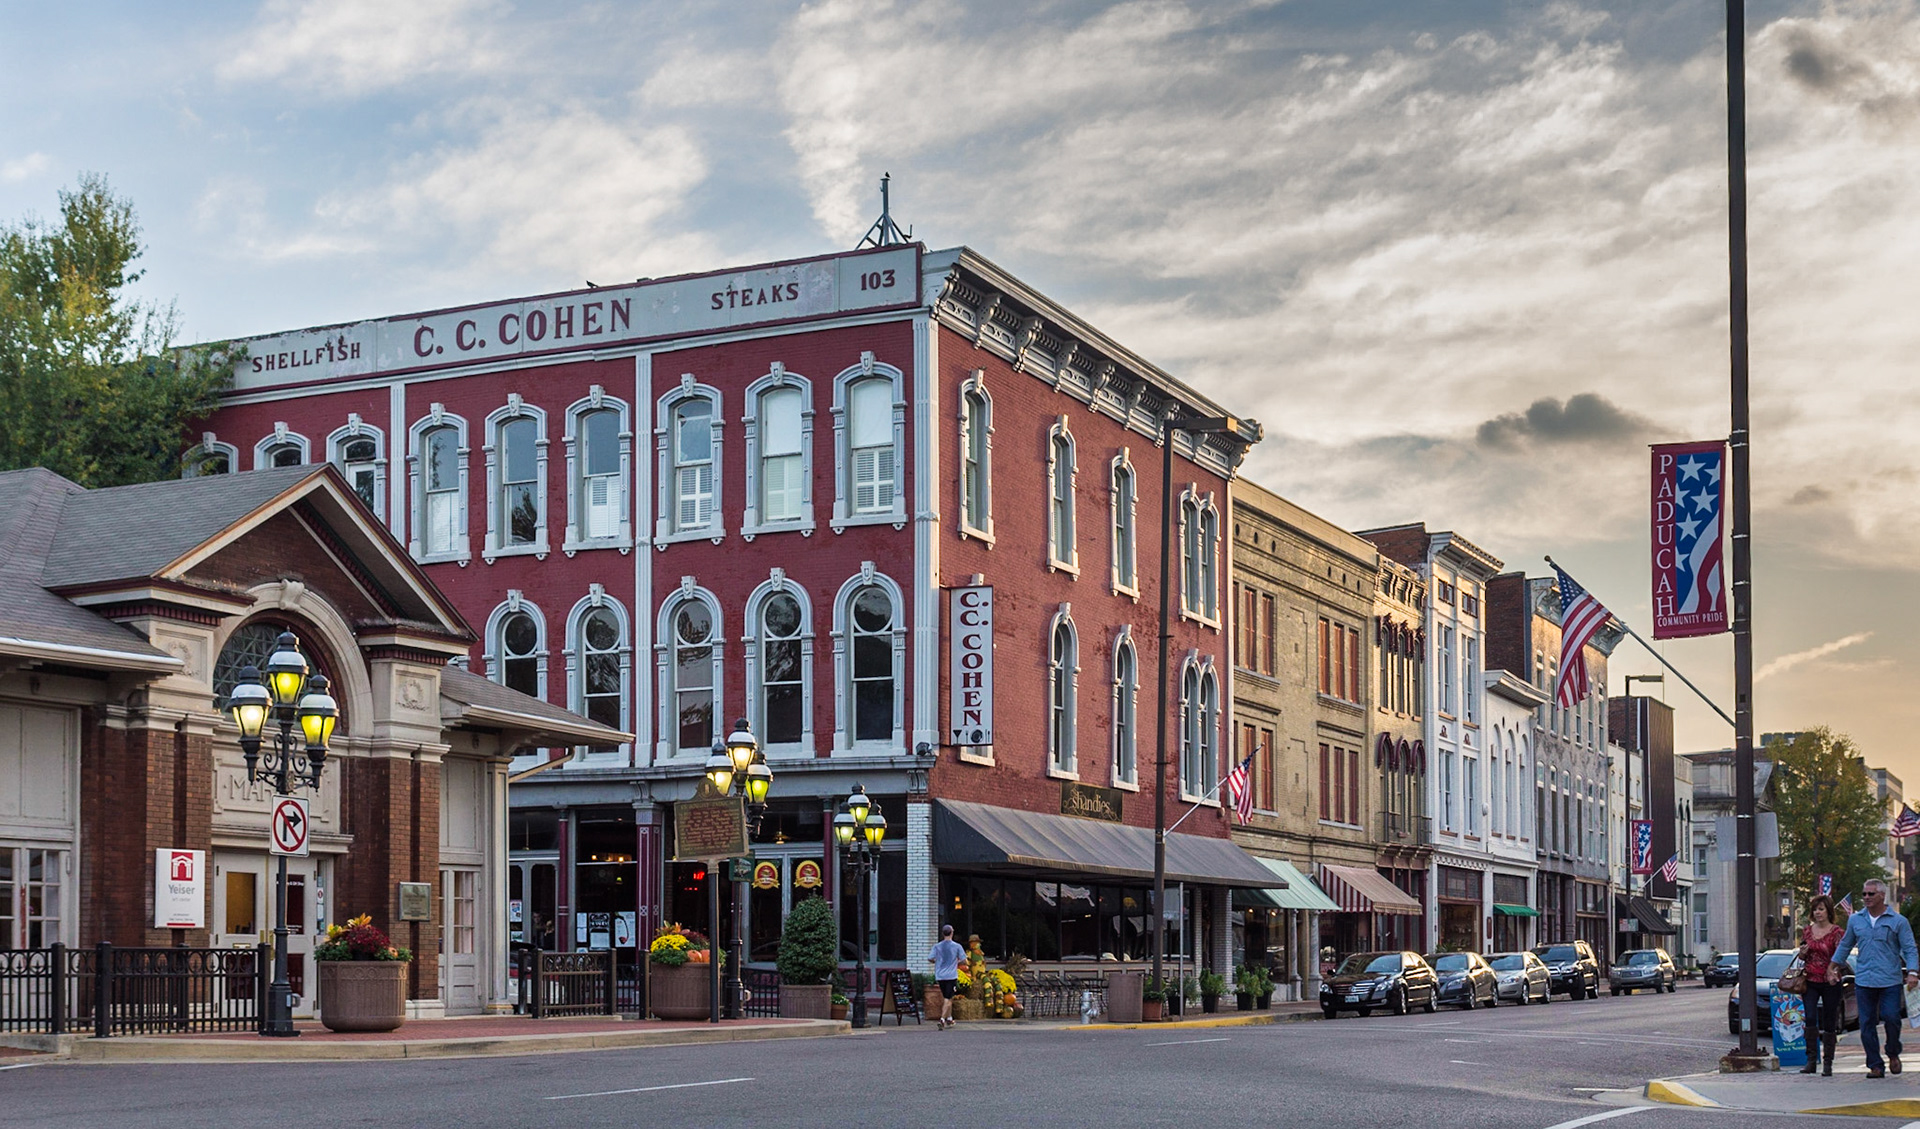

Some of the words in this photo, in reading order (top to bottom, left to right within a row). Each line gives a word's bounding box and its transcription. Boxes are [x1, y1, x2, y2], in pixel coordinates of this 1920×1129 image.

[860, 269, 896, 291] 103
[711, 283, 799, 310] STEAKS
[414, 326, 444, 357] C.
[456, 319, 486, 351] C.
[498, 298, 631, 345] COHEN
[252, 342, 360, 373] SHELLFISH
[1656, 454, 1675, 618] PADUCAH
[960, 591, 989, 608] C.
[960, 610, 989, 626] C.
[1657, 614, 1700, 627] COMMUNITY
[1702, 612, 1724, 623] PRIDE
[961, 633, 984, 726] COHEN
[168, 884, 196, 895] Yeiser
